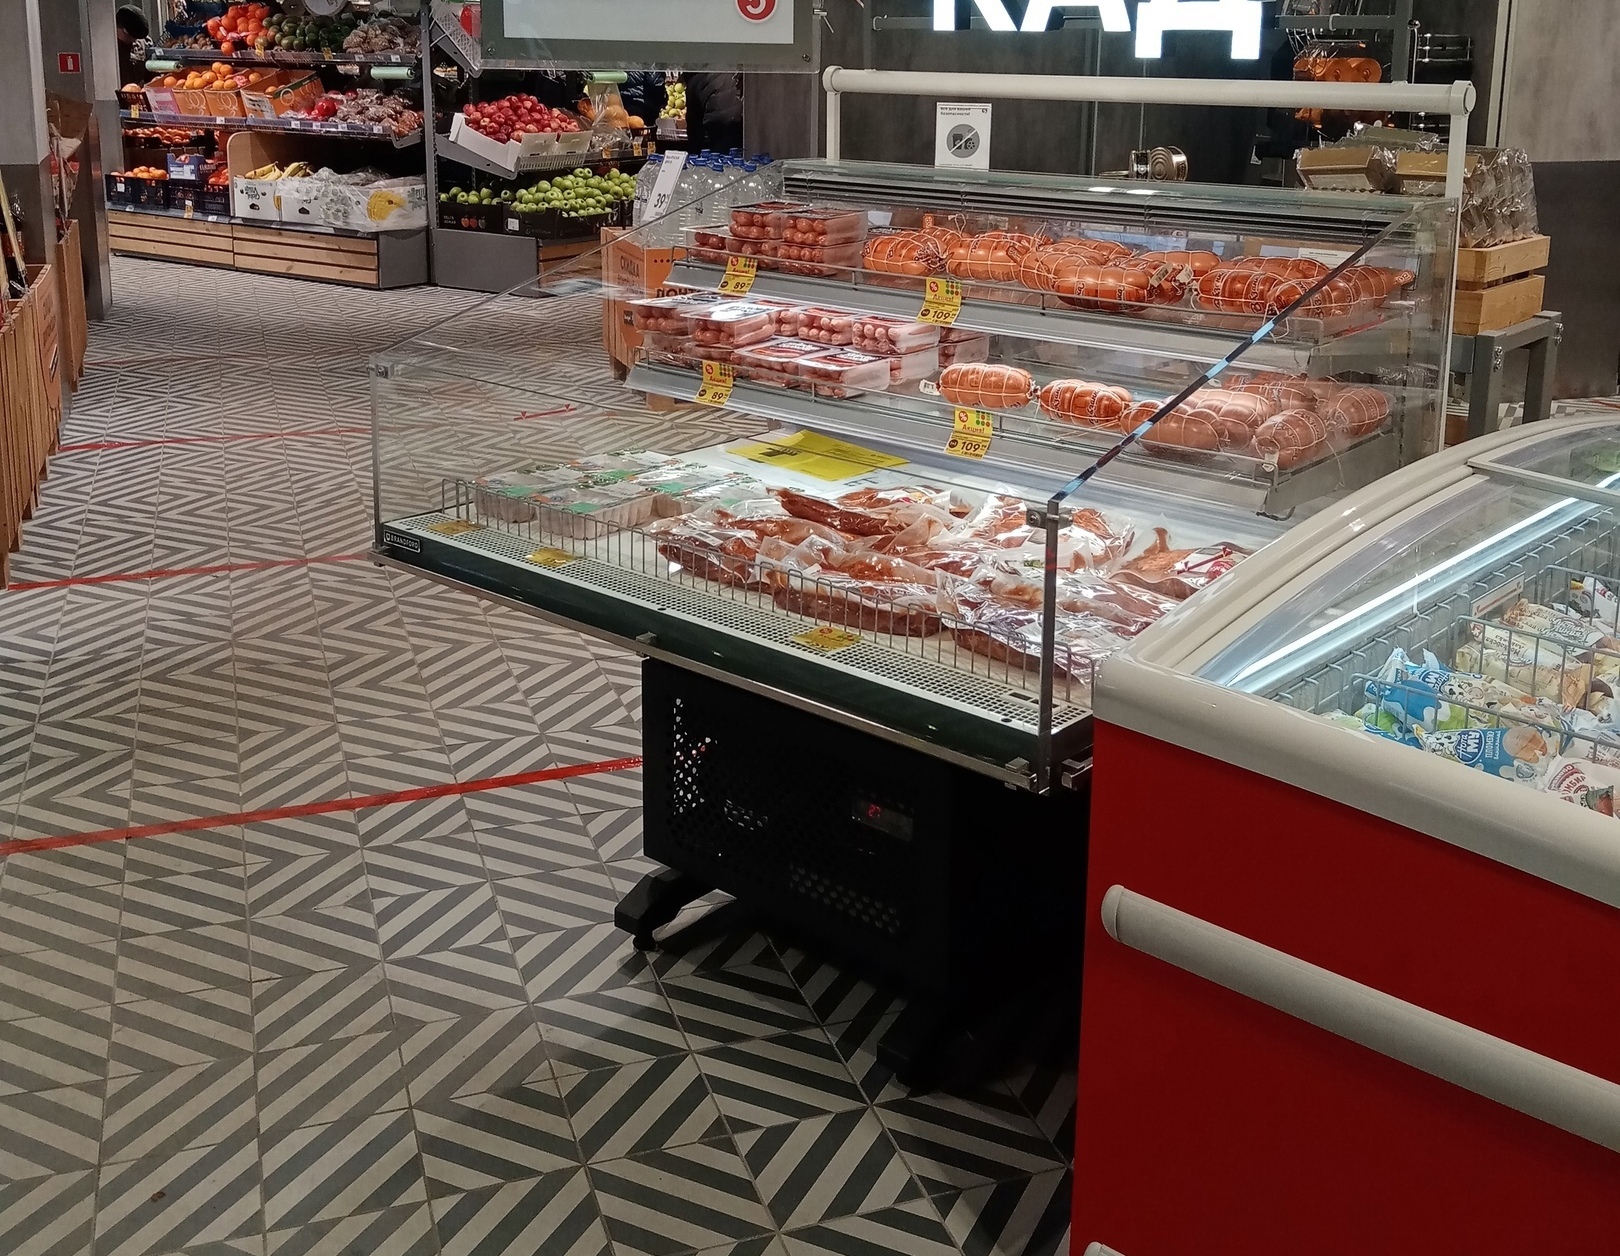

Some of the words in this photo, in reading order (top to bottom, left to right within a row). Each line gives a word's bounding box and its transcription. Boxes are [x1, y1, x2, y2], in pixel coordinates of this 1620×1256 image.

[733, 281, 746, 290] 89
[932, 310, 951, 320] 109
[711, 391, 724, 401] 89
[962, 424, 985, 433] Акция!
[961, 441, 980, 452] 109
[1469, 730, 1481, 753] МУ
